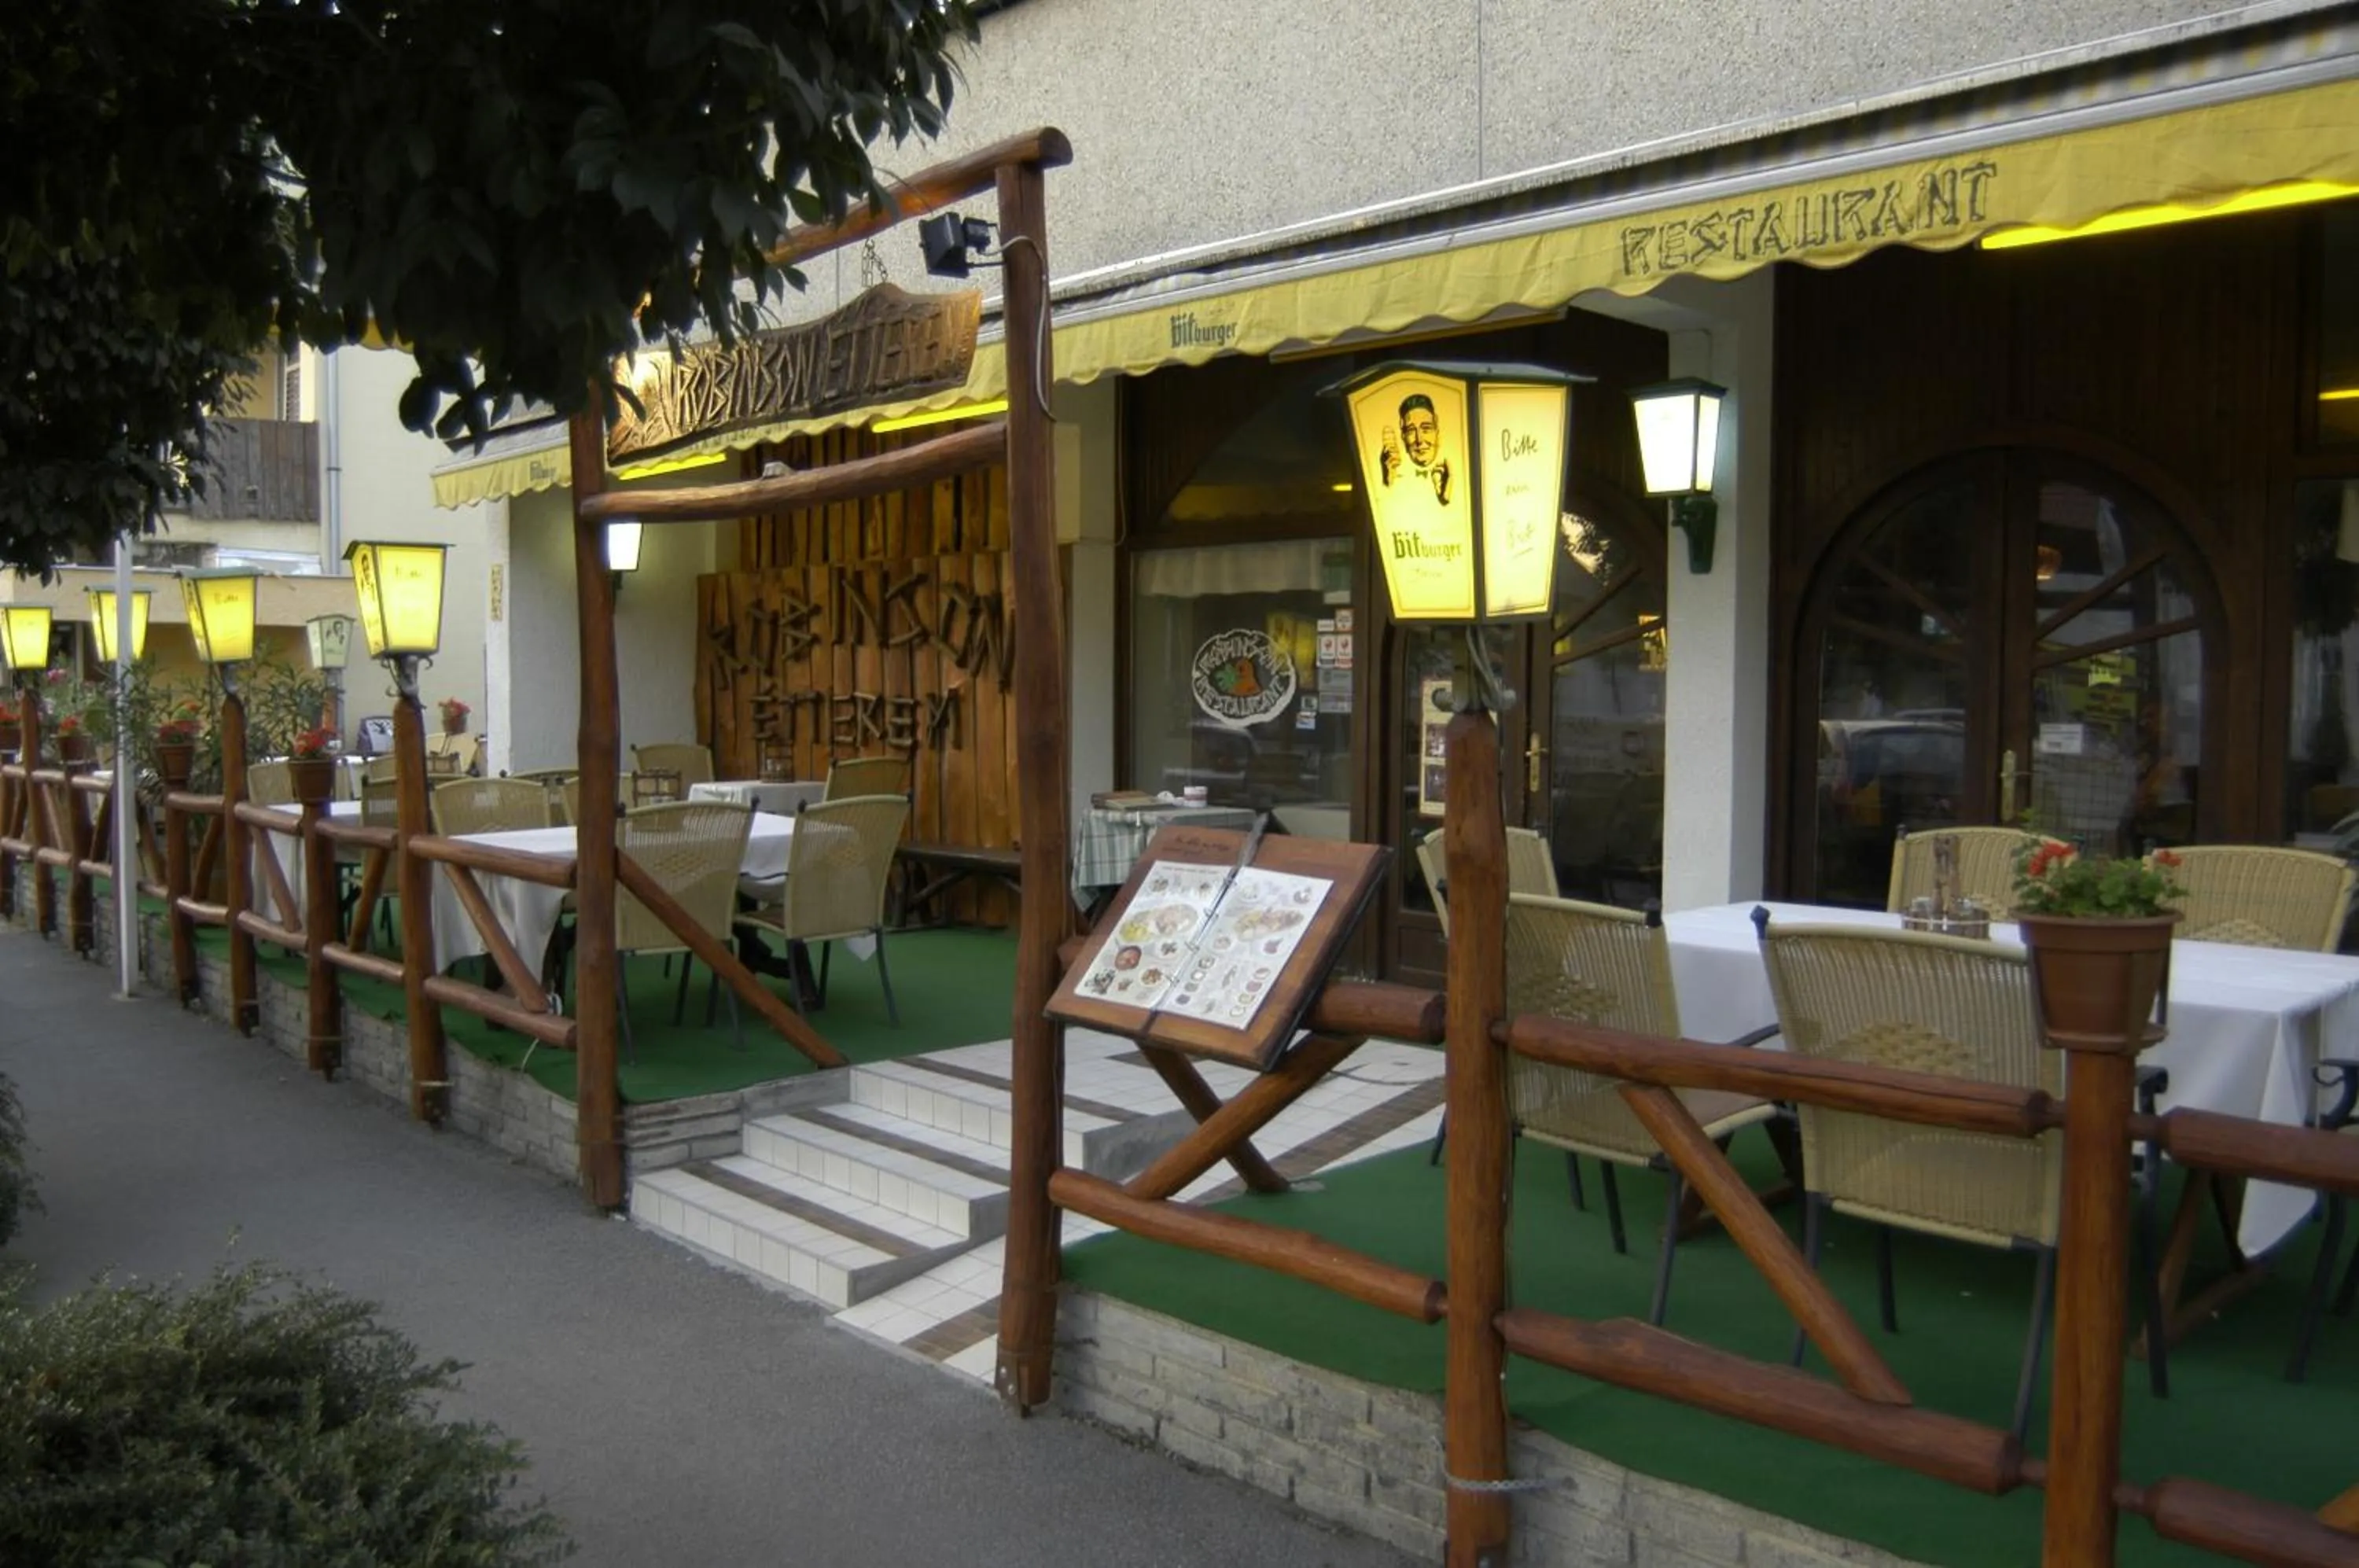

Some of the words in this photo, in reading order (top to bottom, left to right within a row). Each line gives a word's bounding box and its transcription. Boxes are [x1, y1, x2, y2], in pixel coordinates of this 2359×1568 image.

[1621, 161, 1997, 276] RESTAURANT
[674, 333, 817, 432] ROBINSON
[1501, 428, 1539, 462] Bitte
[708, 566, 1016, 692] ROBINSON
